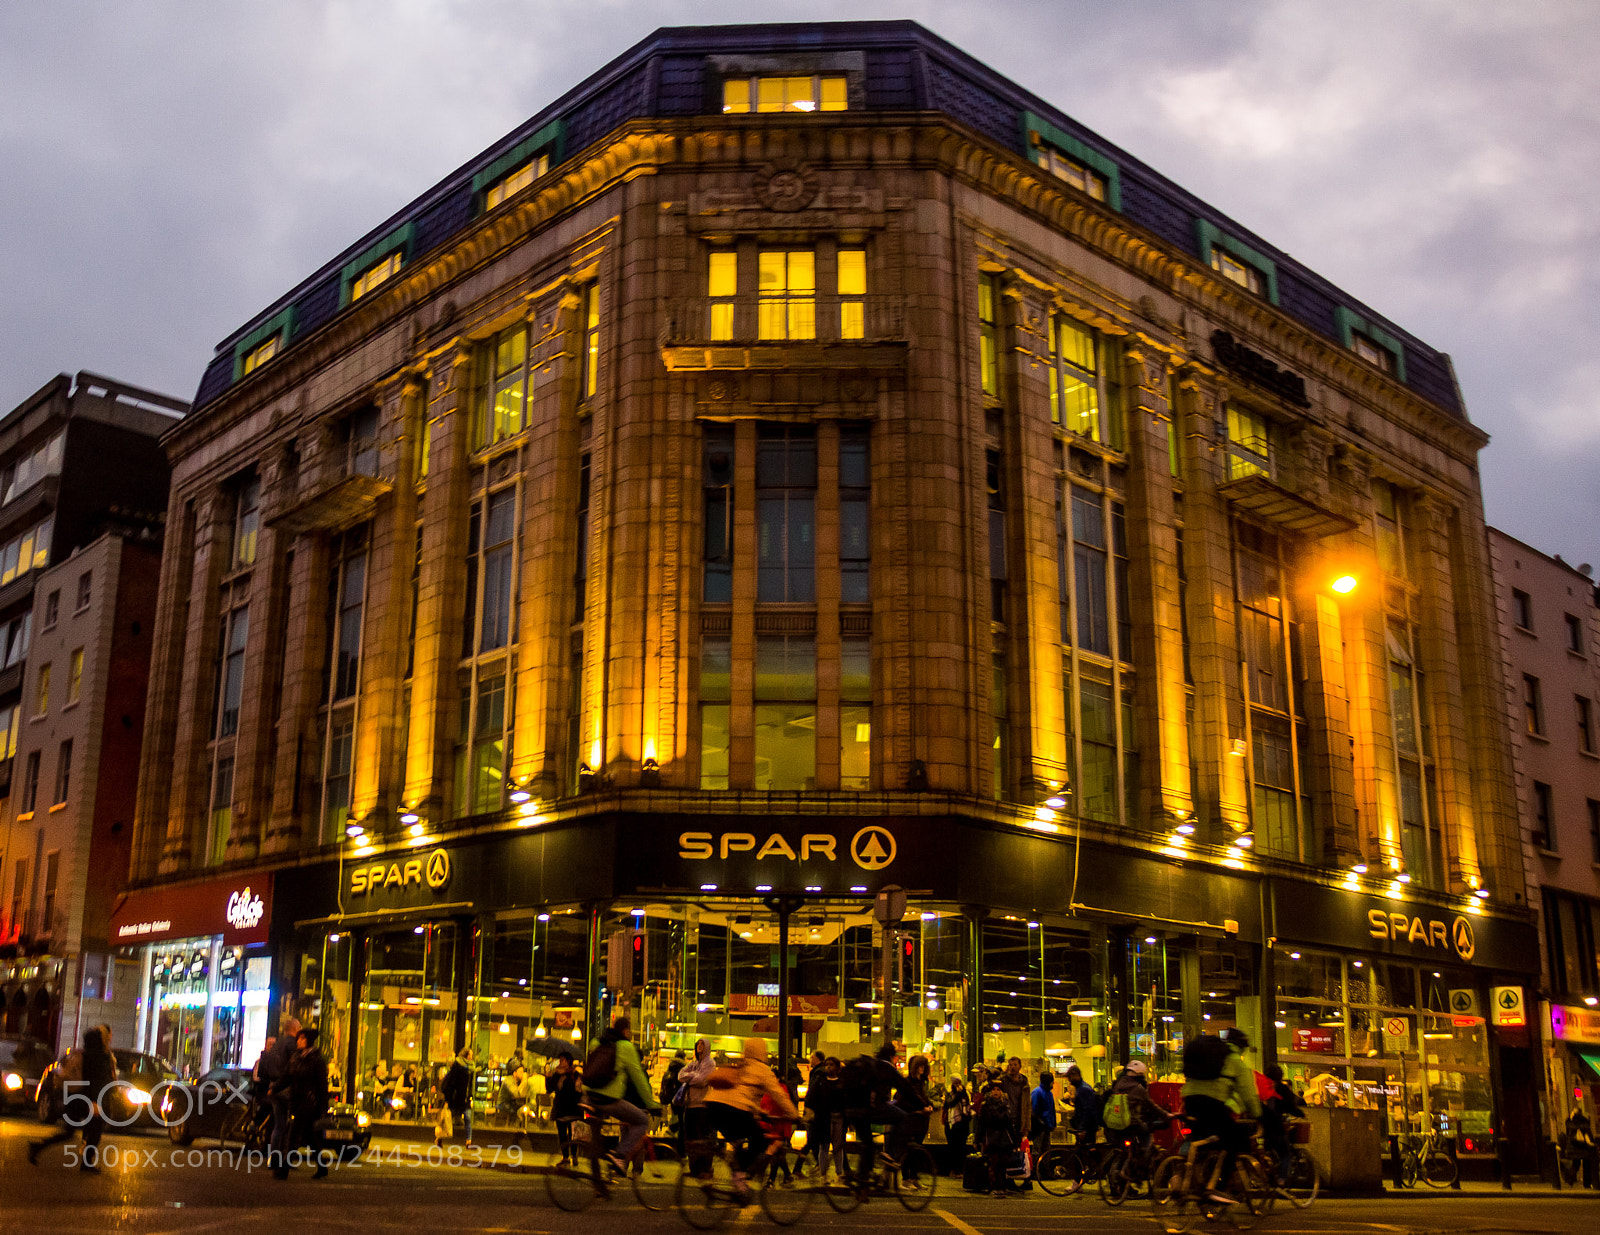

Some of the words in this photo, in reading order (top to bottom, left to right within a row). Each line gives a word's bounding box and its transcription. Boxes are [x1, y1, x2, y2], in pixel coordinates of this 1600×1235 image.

[678, 831, 838, 861] SPAR
[350, 859, 422, 894] SPAR
[1368, 909, 1449, 949] SPAR
[747, 995, 793, 1007] INSOMA
